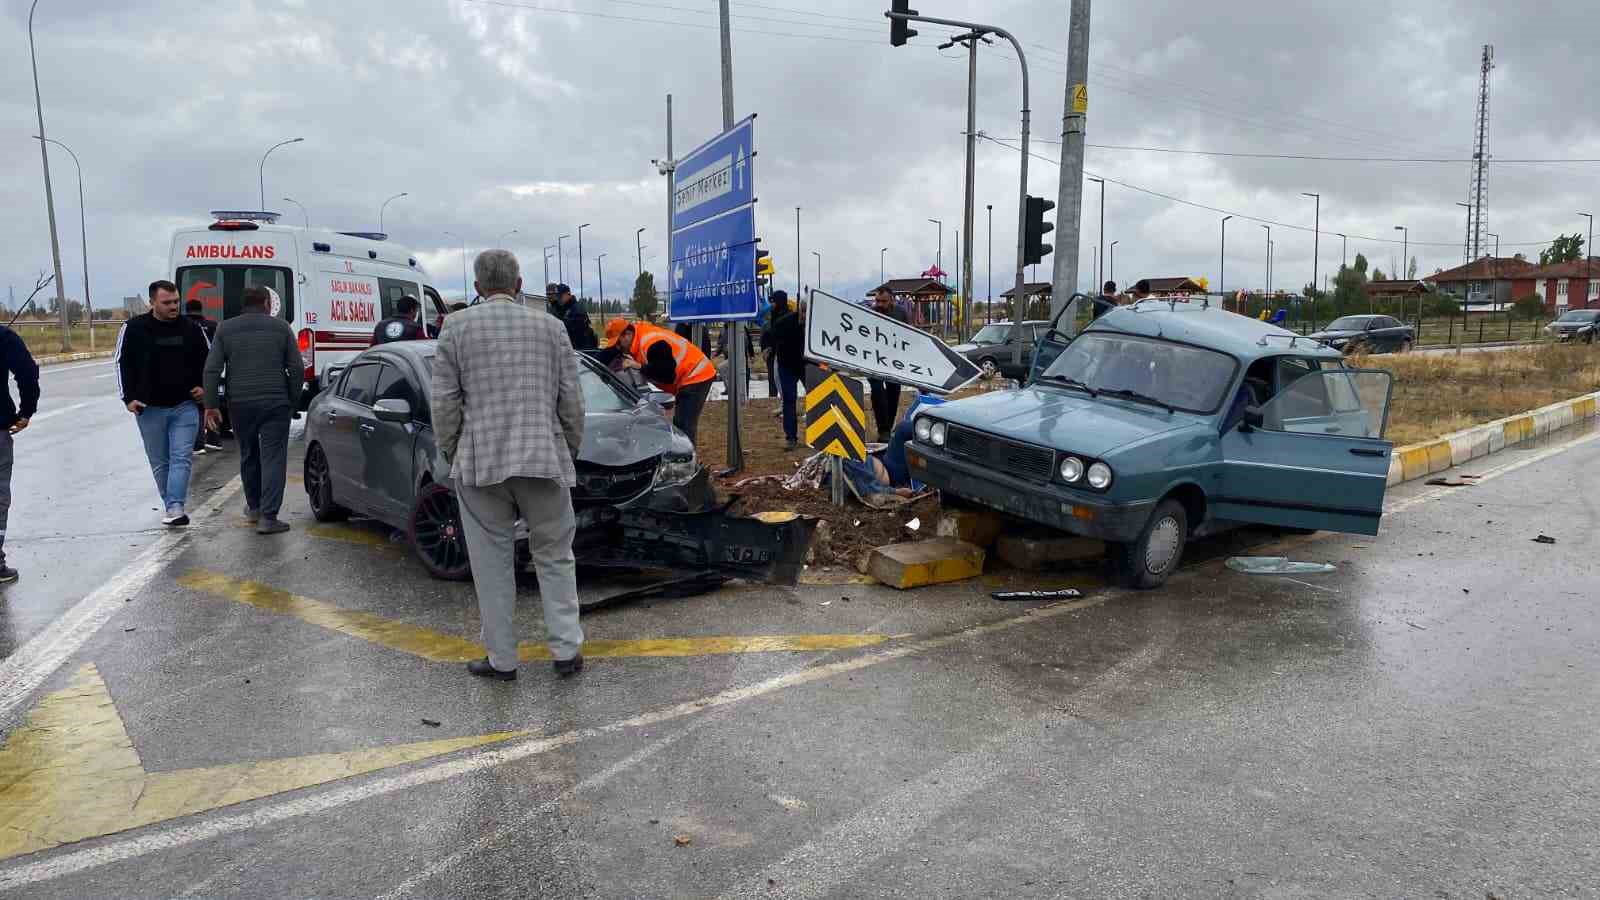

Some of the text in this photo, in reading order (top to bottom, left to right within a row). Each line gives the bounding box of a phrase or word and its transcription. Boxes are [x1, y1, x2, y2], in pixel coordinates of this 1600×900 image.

[186, 245, 275, 259] AMBULANS
[305, 311, 317, 324] 112
[349, 300, 375, 323] SAĞLIK
[840, 312, 910, 351] Şehir
